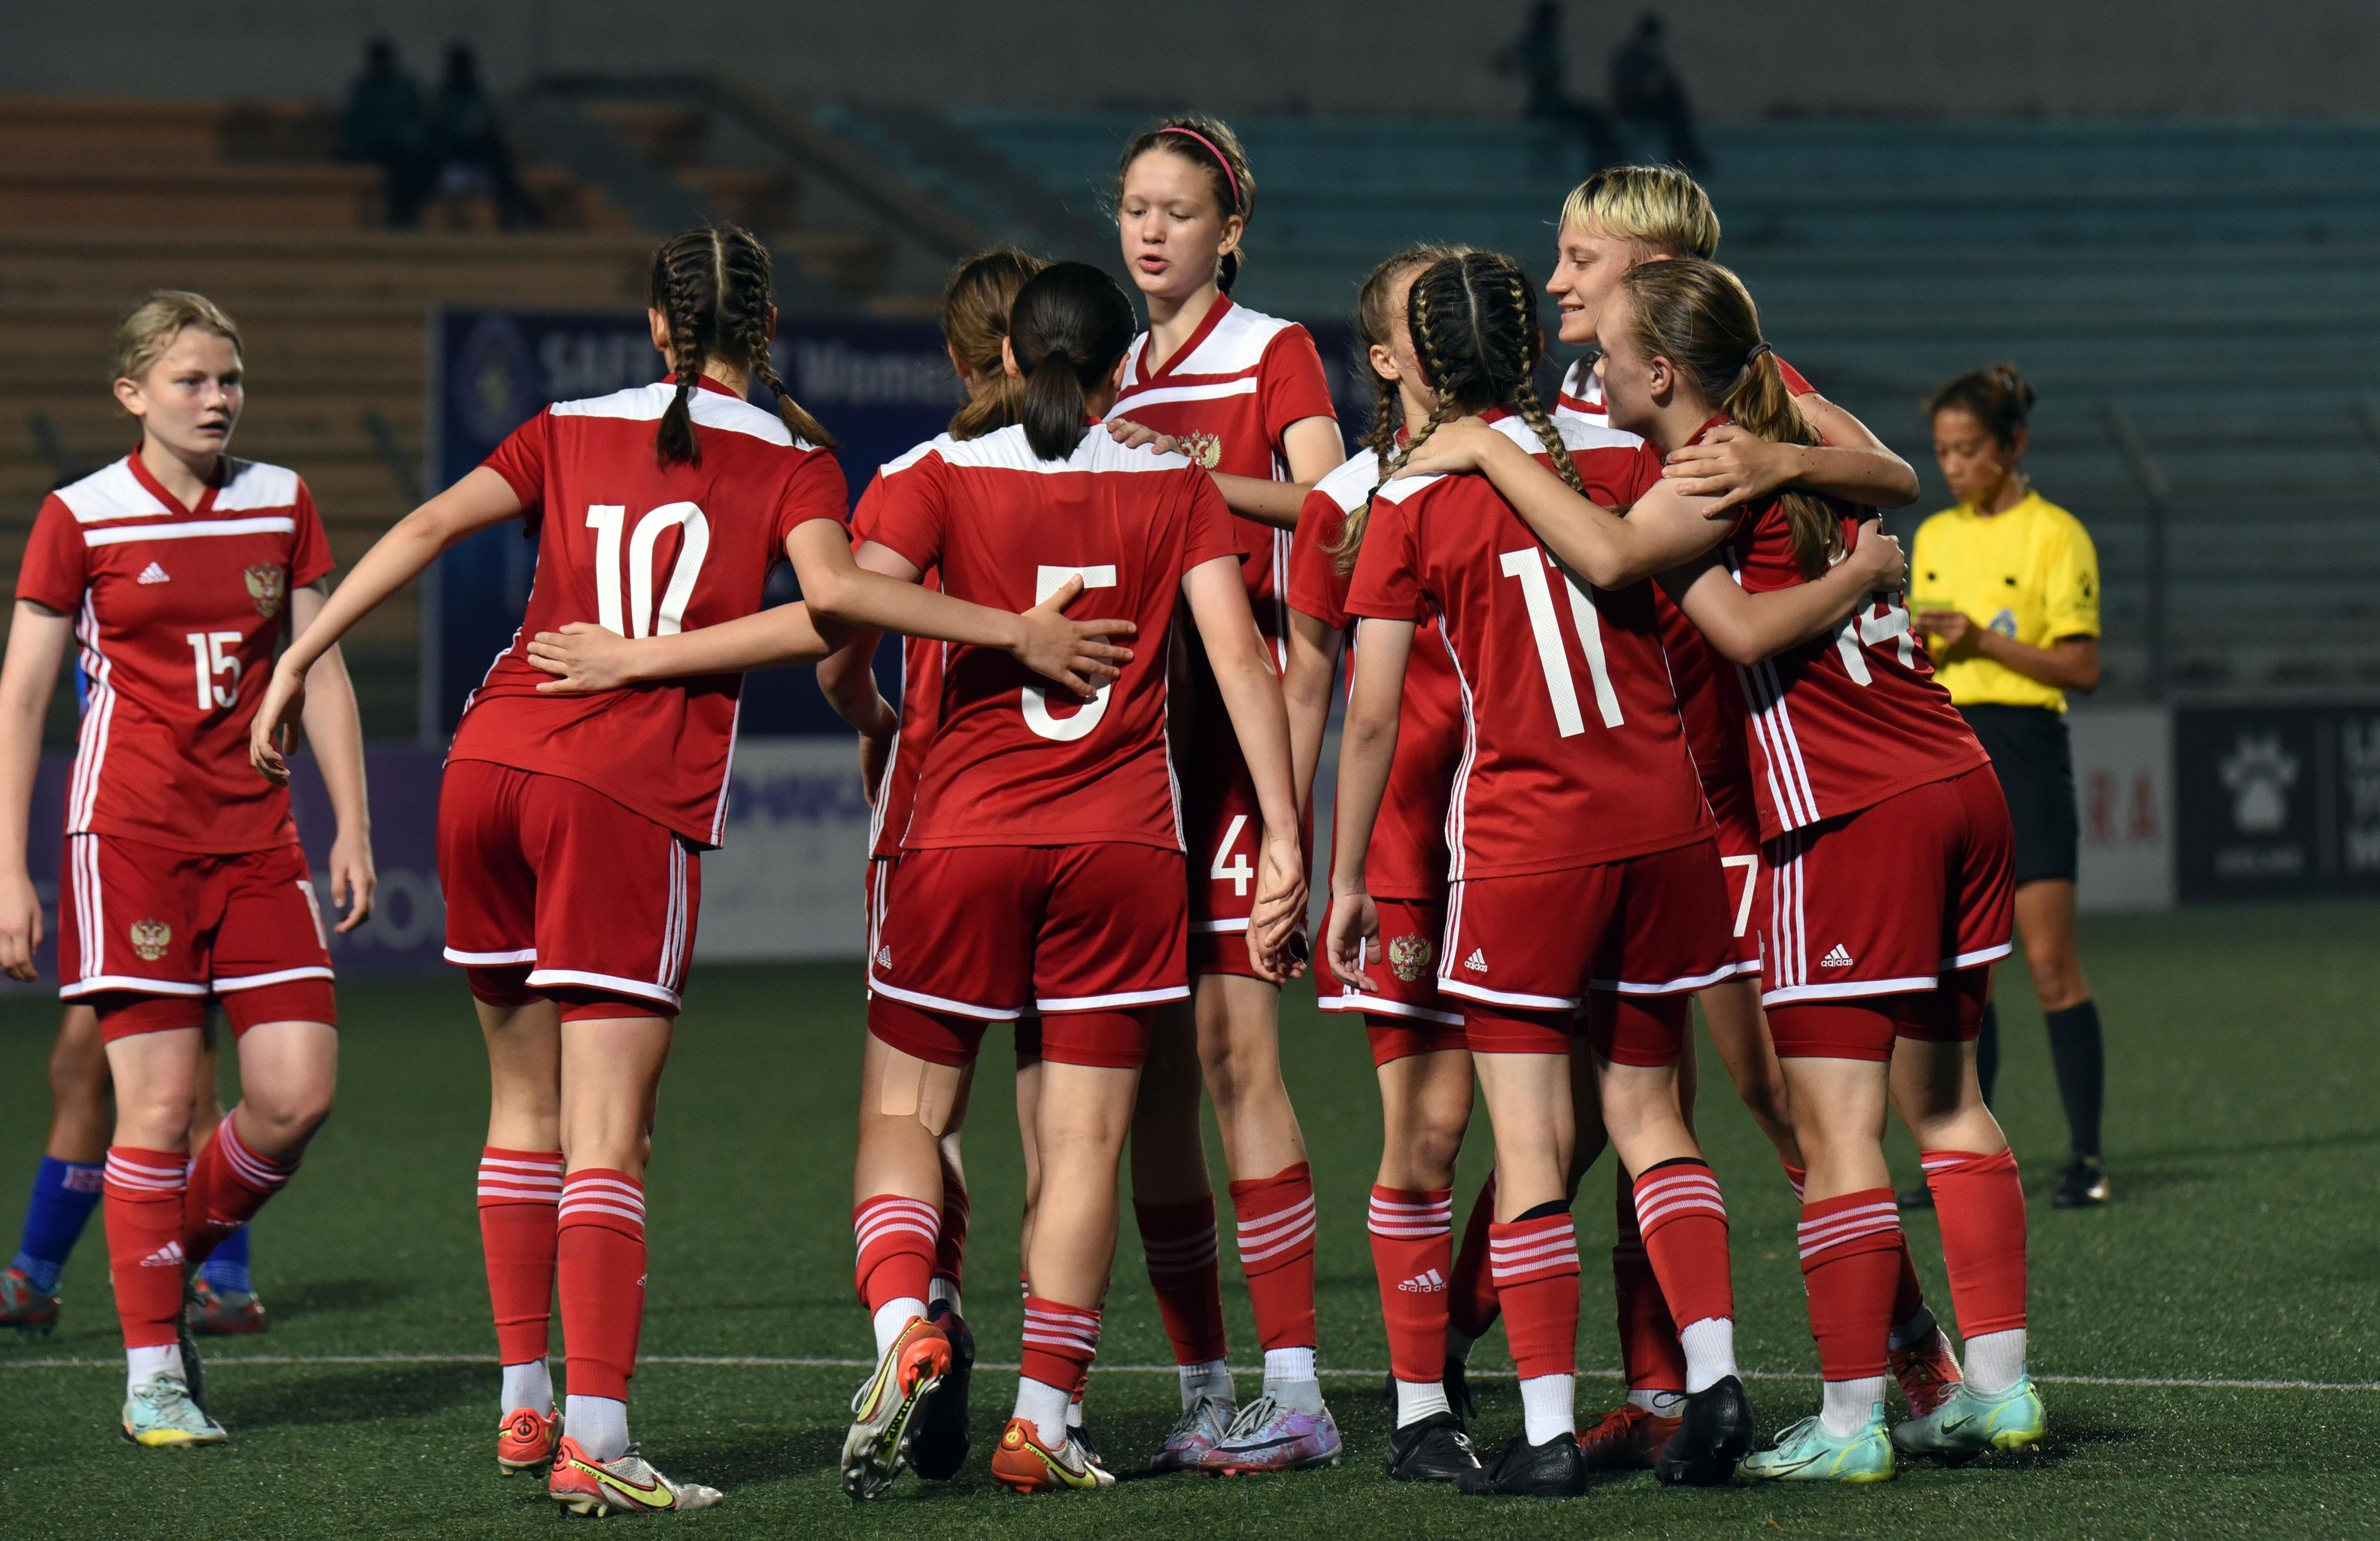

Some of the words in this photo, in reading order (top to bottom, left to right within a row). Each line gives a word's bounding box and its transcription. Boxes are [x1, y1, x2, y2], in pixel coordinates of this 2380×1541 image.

[586, 501, 709, 640] 10
[187, 632, 242, 710] 15
[1500, 546, 1624, 737] 11
[1210, 815, 1253, 896] 4
[1721, 855, 1758, 938] 7
[1464, 960, 1488, 973] adidas
[1820, 958, 1853, 968] adidas
[1398, 1282, 1447, 1293] adidas
